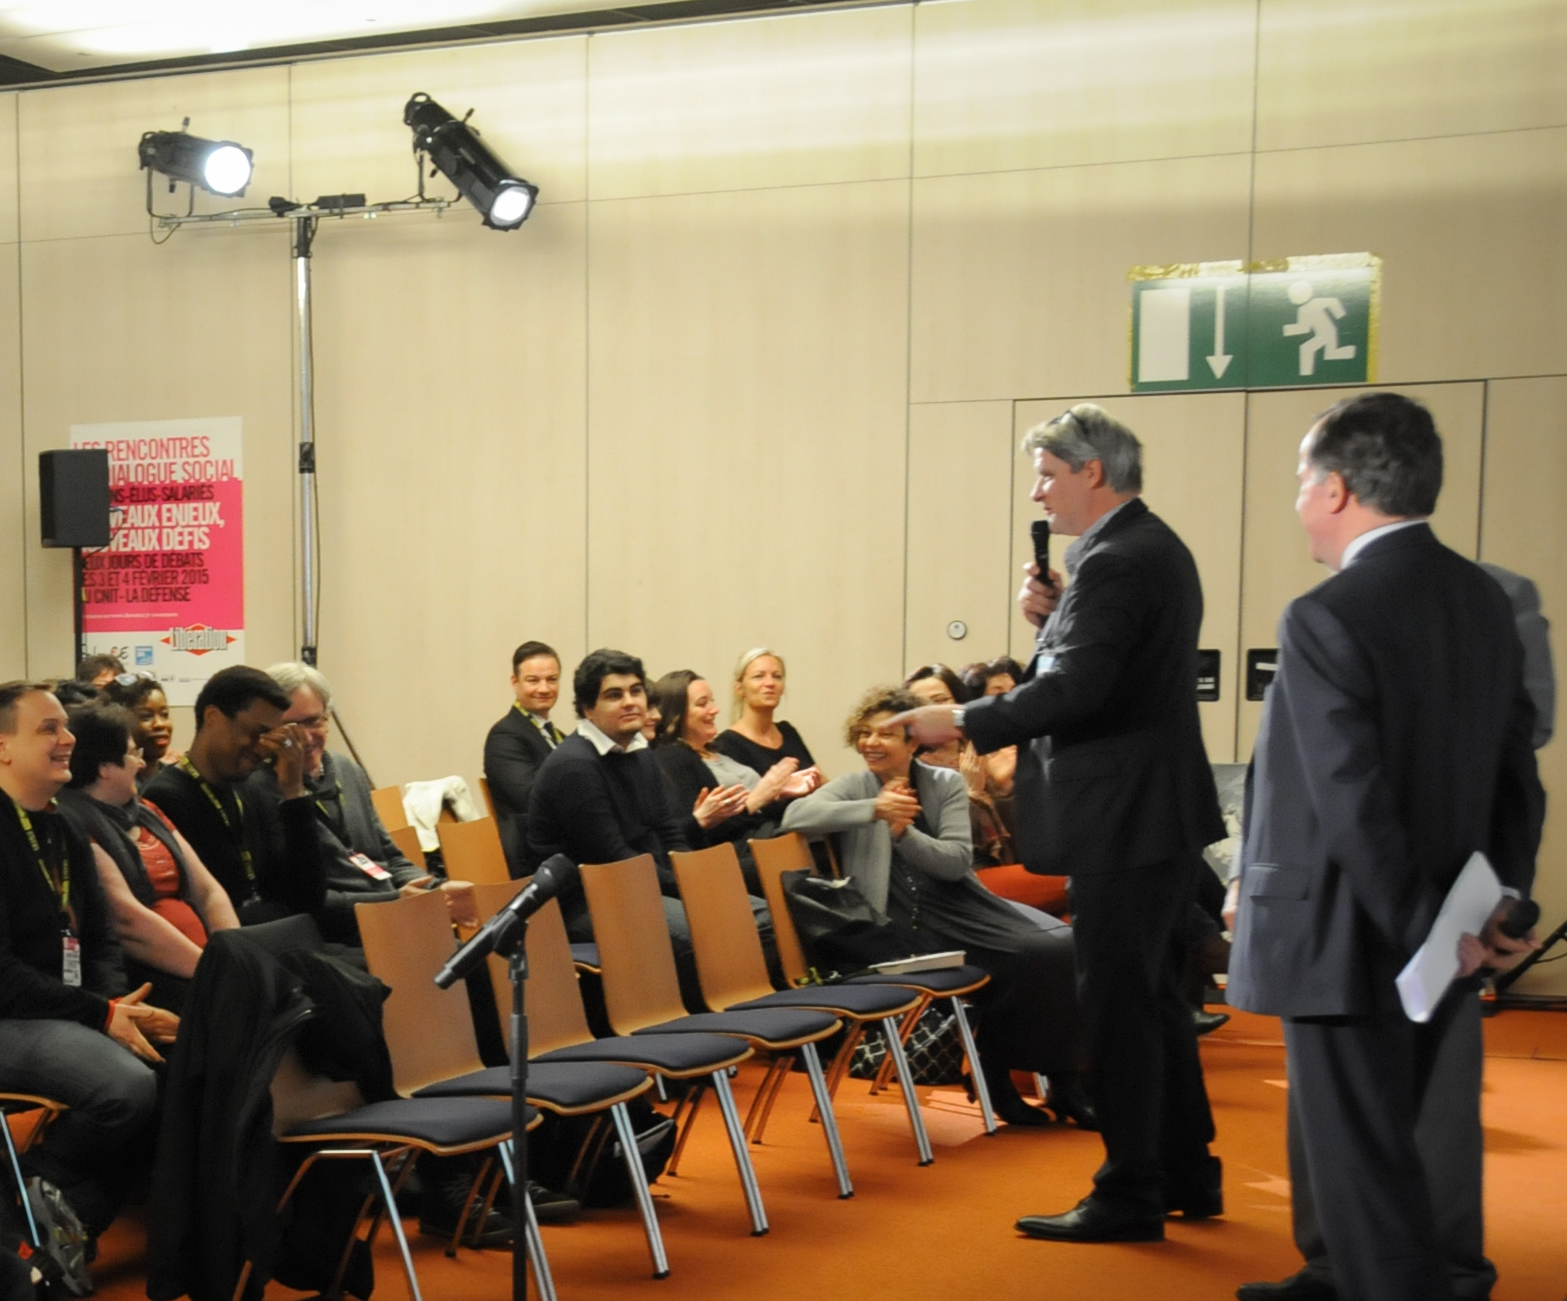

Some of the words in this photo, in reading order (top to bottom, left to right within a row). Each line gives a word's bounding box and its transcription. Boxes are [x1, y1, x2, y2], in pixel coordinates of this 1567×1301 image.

[105, 436, 211, 463] RENCONTRES
[108, 461, 178, 486] IALOGUE
[181, 459, 235, 483] SOCIAL
[109, 504, 160, 528] VEAUX
[161, 501, 226, 528] ENJEUX,
[162, 525, 211, 551] DÉFIS
[106, 554, 141, 570] JOURS
[144, 553, 159, 568] DE
[161, 552, 204, 568] DÉBATS
[107, 571, 120, 586] ET
[121, 571, 130, 586] 4
[133, 569, 179, 586] FÉVRIER
[181, 568, 210, 584] 2015
[94, 588, 119, 604] CNIT
[126, 587, 139, 602] LA
[141, 586, 191, 602] DÉFENSE
